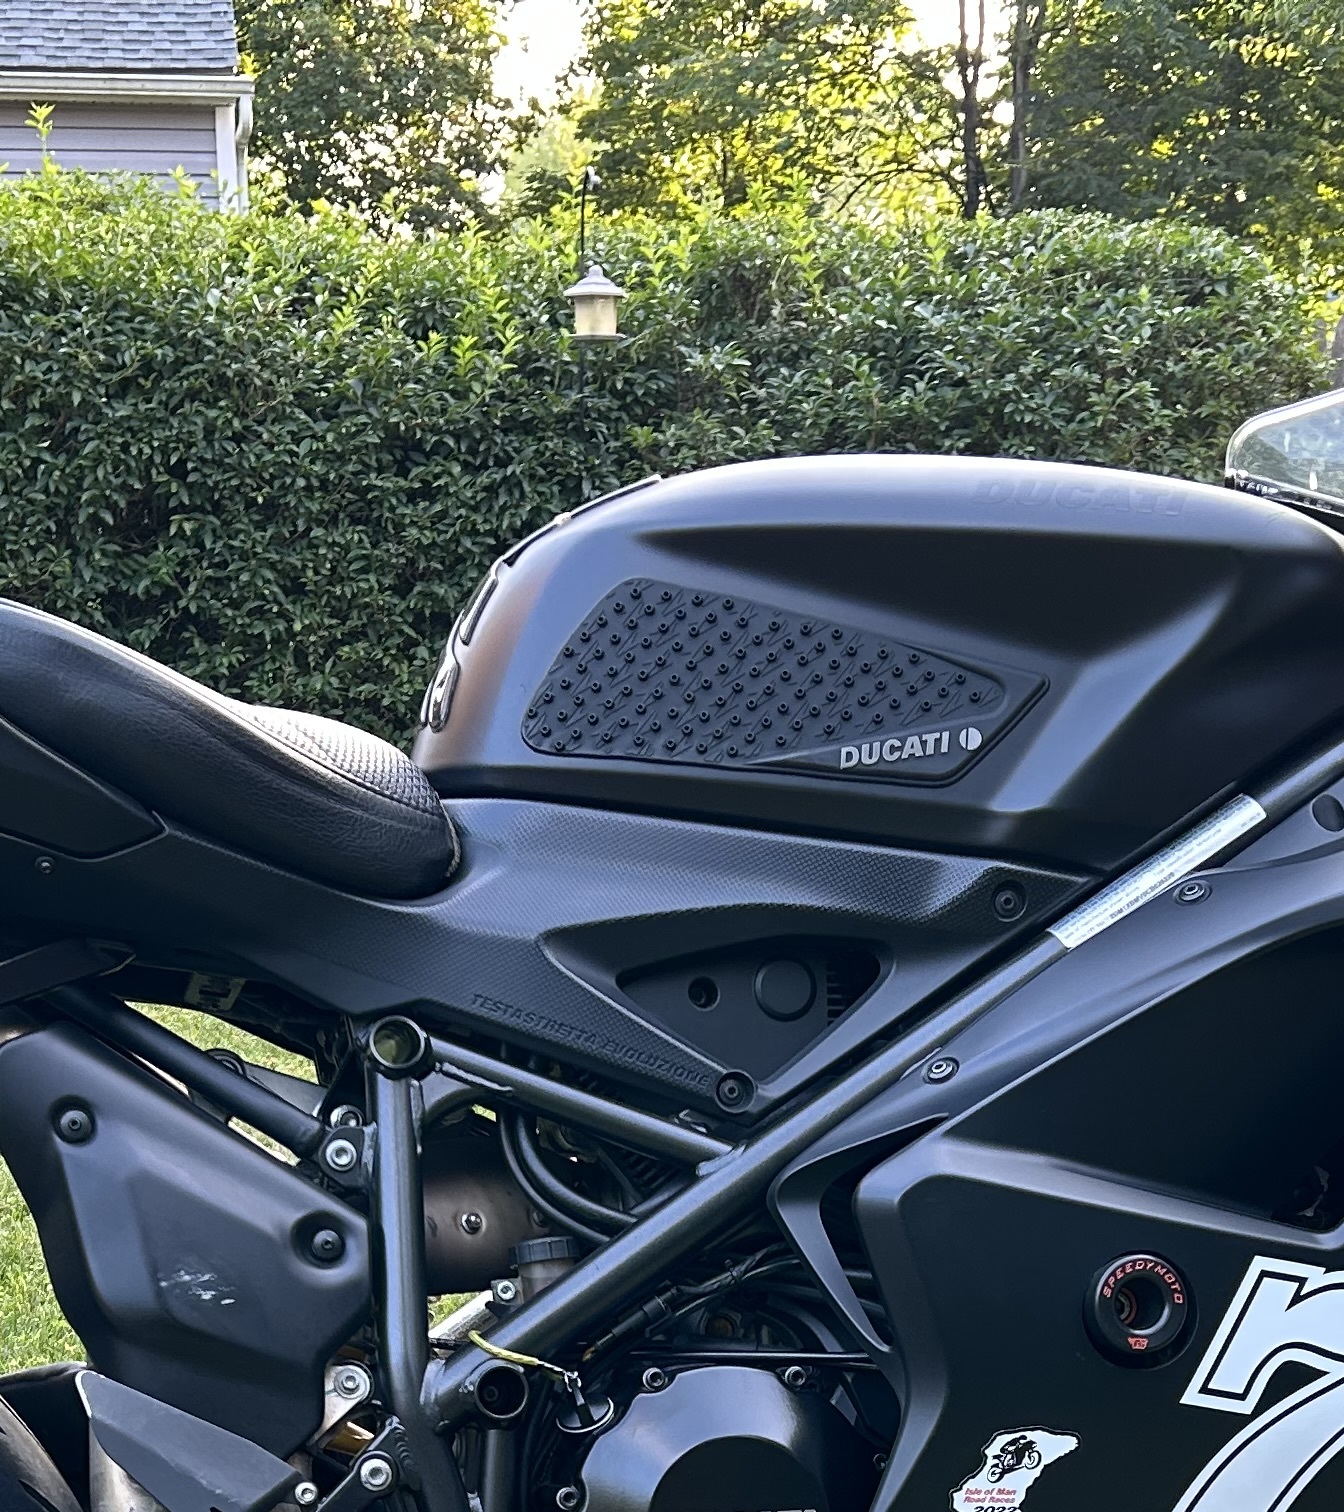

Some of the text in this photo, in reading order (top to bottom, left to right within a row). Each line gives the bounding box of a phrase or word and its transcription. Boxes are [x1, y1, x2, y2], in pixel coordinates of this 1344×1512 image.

[968, 478, 1188, 516] DUCATI
[840, 730, 952, 770] DUCATI
[472, 992, 711, 1088] TESTASTRETTA EVOLUZIONE
[1102, 1260, 1184, 1304] SPEEDYMOTO
[964, 1487, 1017, 1496] Isle of Man
